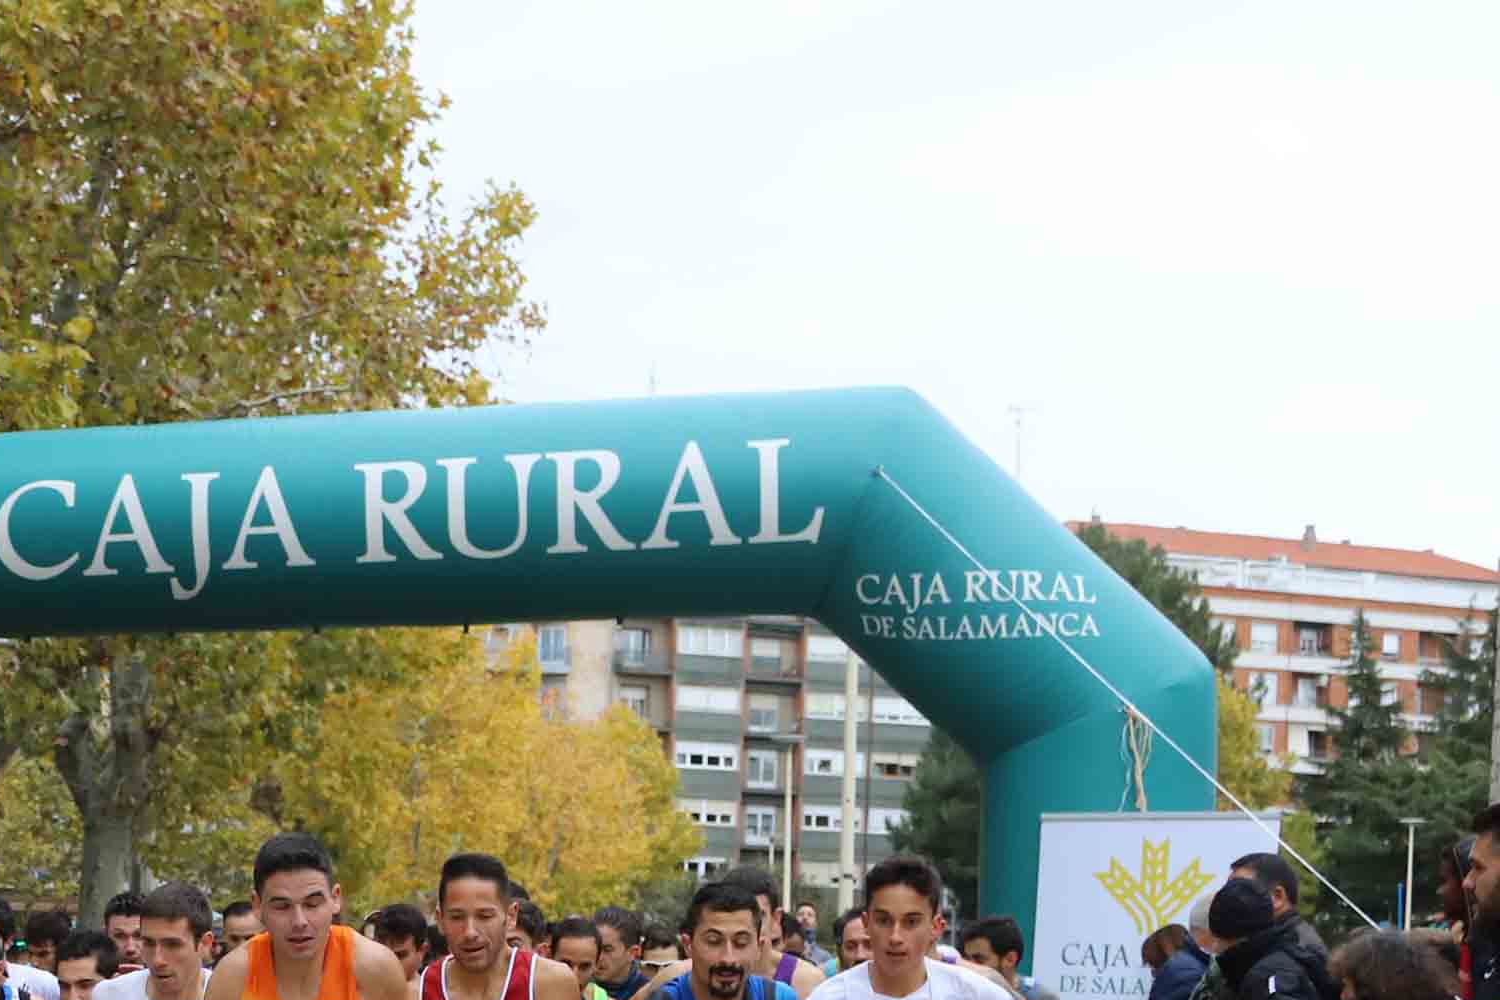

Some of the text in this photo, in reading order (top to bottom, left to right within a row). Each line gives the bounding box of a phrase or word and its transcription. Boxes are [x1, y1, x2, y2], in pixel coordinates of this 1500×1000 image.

[353, 437, 826, 564] RURAL
[856, 569, 1097, 614] CAJA RURAL
[860, 612, 1100, 641] DE SALAMANCA
[1061, 943, 1131, 974] CAJA
[1060, 975, 1148, 996] DE SALA
